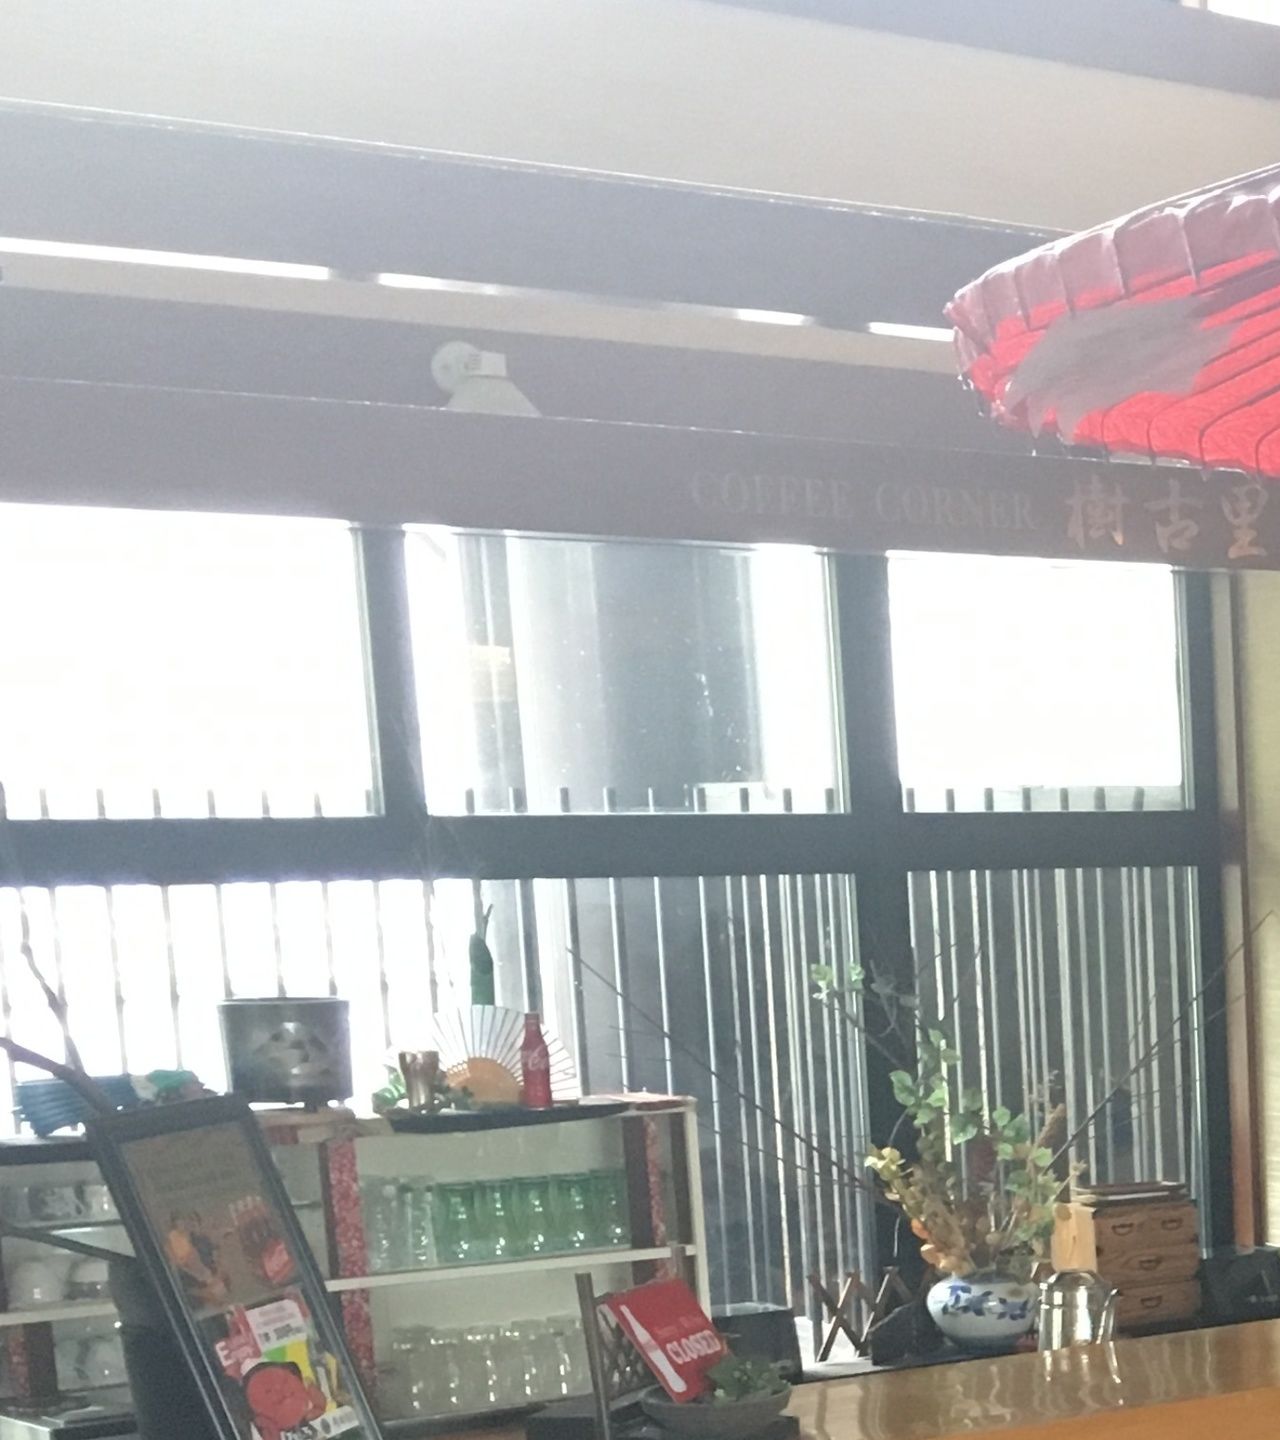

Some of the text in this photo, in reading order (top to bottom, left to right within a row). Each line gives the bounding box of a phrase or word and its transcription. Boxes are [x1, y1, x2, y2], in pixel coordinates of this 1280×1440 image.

[691, 471, 1037, 532] COFFEE CORNER
[1065, 474, 1269, 559] 樹古里
[666, 1329, 722, 1365] CLOSED
